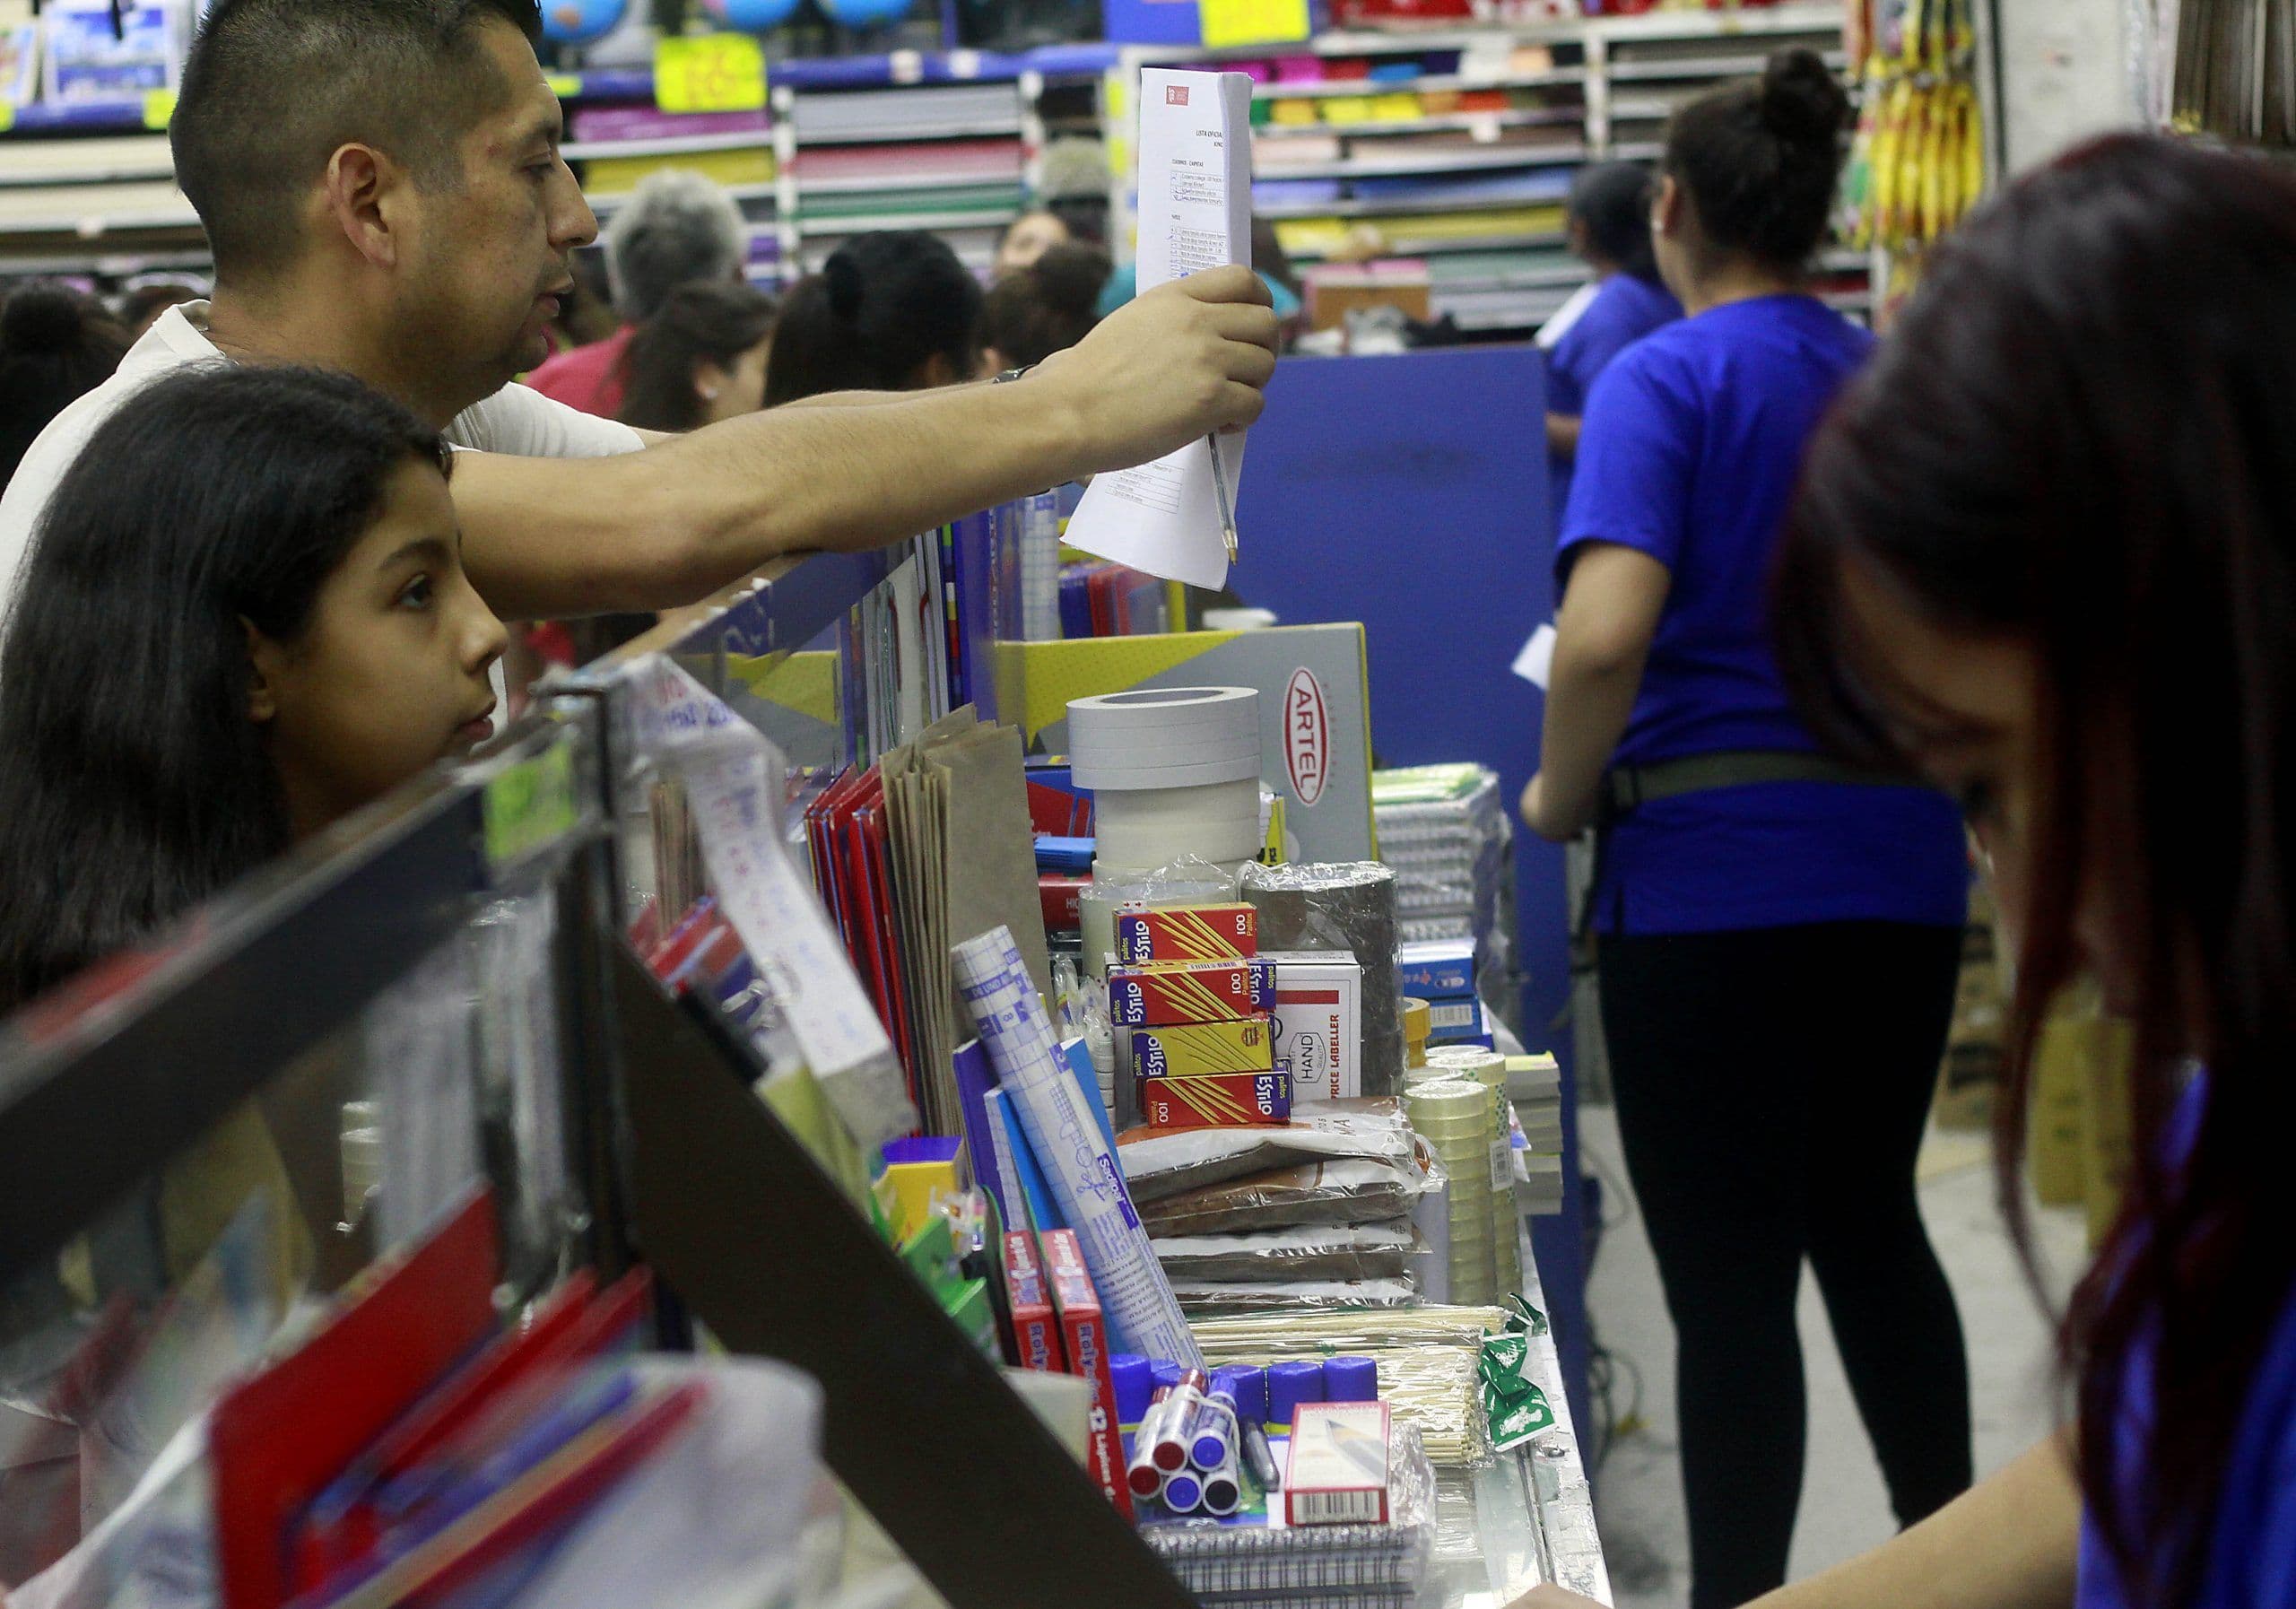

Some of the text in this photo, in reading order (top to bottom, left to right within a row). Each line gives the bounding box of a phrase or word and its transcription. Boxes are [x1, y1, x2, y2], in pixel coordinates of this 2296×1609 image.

[1295, 686, 1317, 789] ARTEL
[1135, 920, 1151, 961] ESTILO
[1236, 914, 1246, 935] 100
[1122, 937, 1131, 961] palitos
[1231, 973, 1242, 994] 100
[1241, 970, 1249, 996] Palitos
[1112, 999, 1123, 1023] palitos
[1126, 982, 1144, 1023] ESTILO
[1147, 1036, 1165, 1075] ESTILO
[1329, 1013, 1340, 1068] LABELLER
[1134, 1053, 1144, 1076] palitos
[1300, 1034, 1314, 1080] HAND
[1256, 1076, 1274, 1116] ESTILO
[1277, 1075, 1288, 1100] palitos
[1158, 1102, 1169, 1123] 100
[1100, 1158, 1126, 1203] Sadipal
